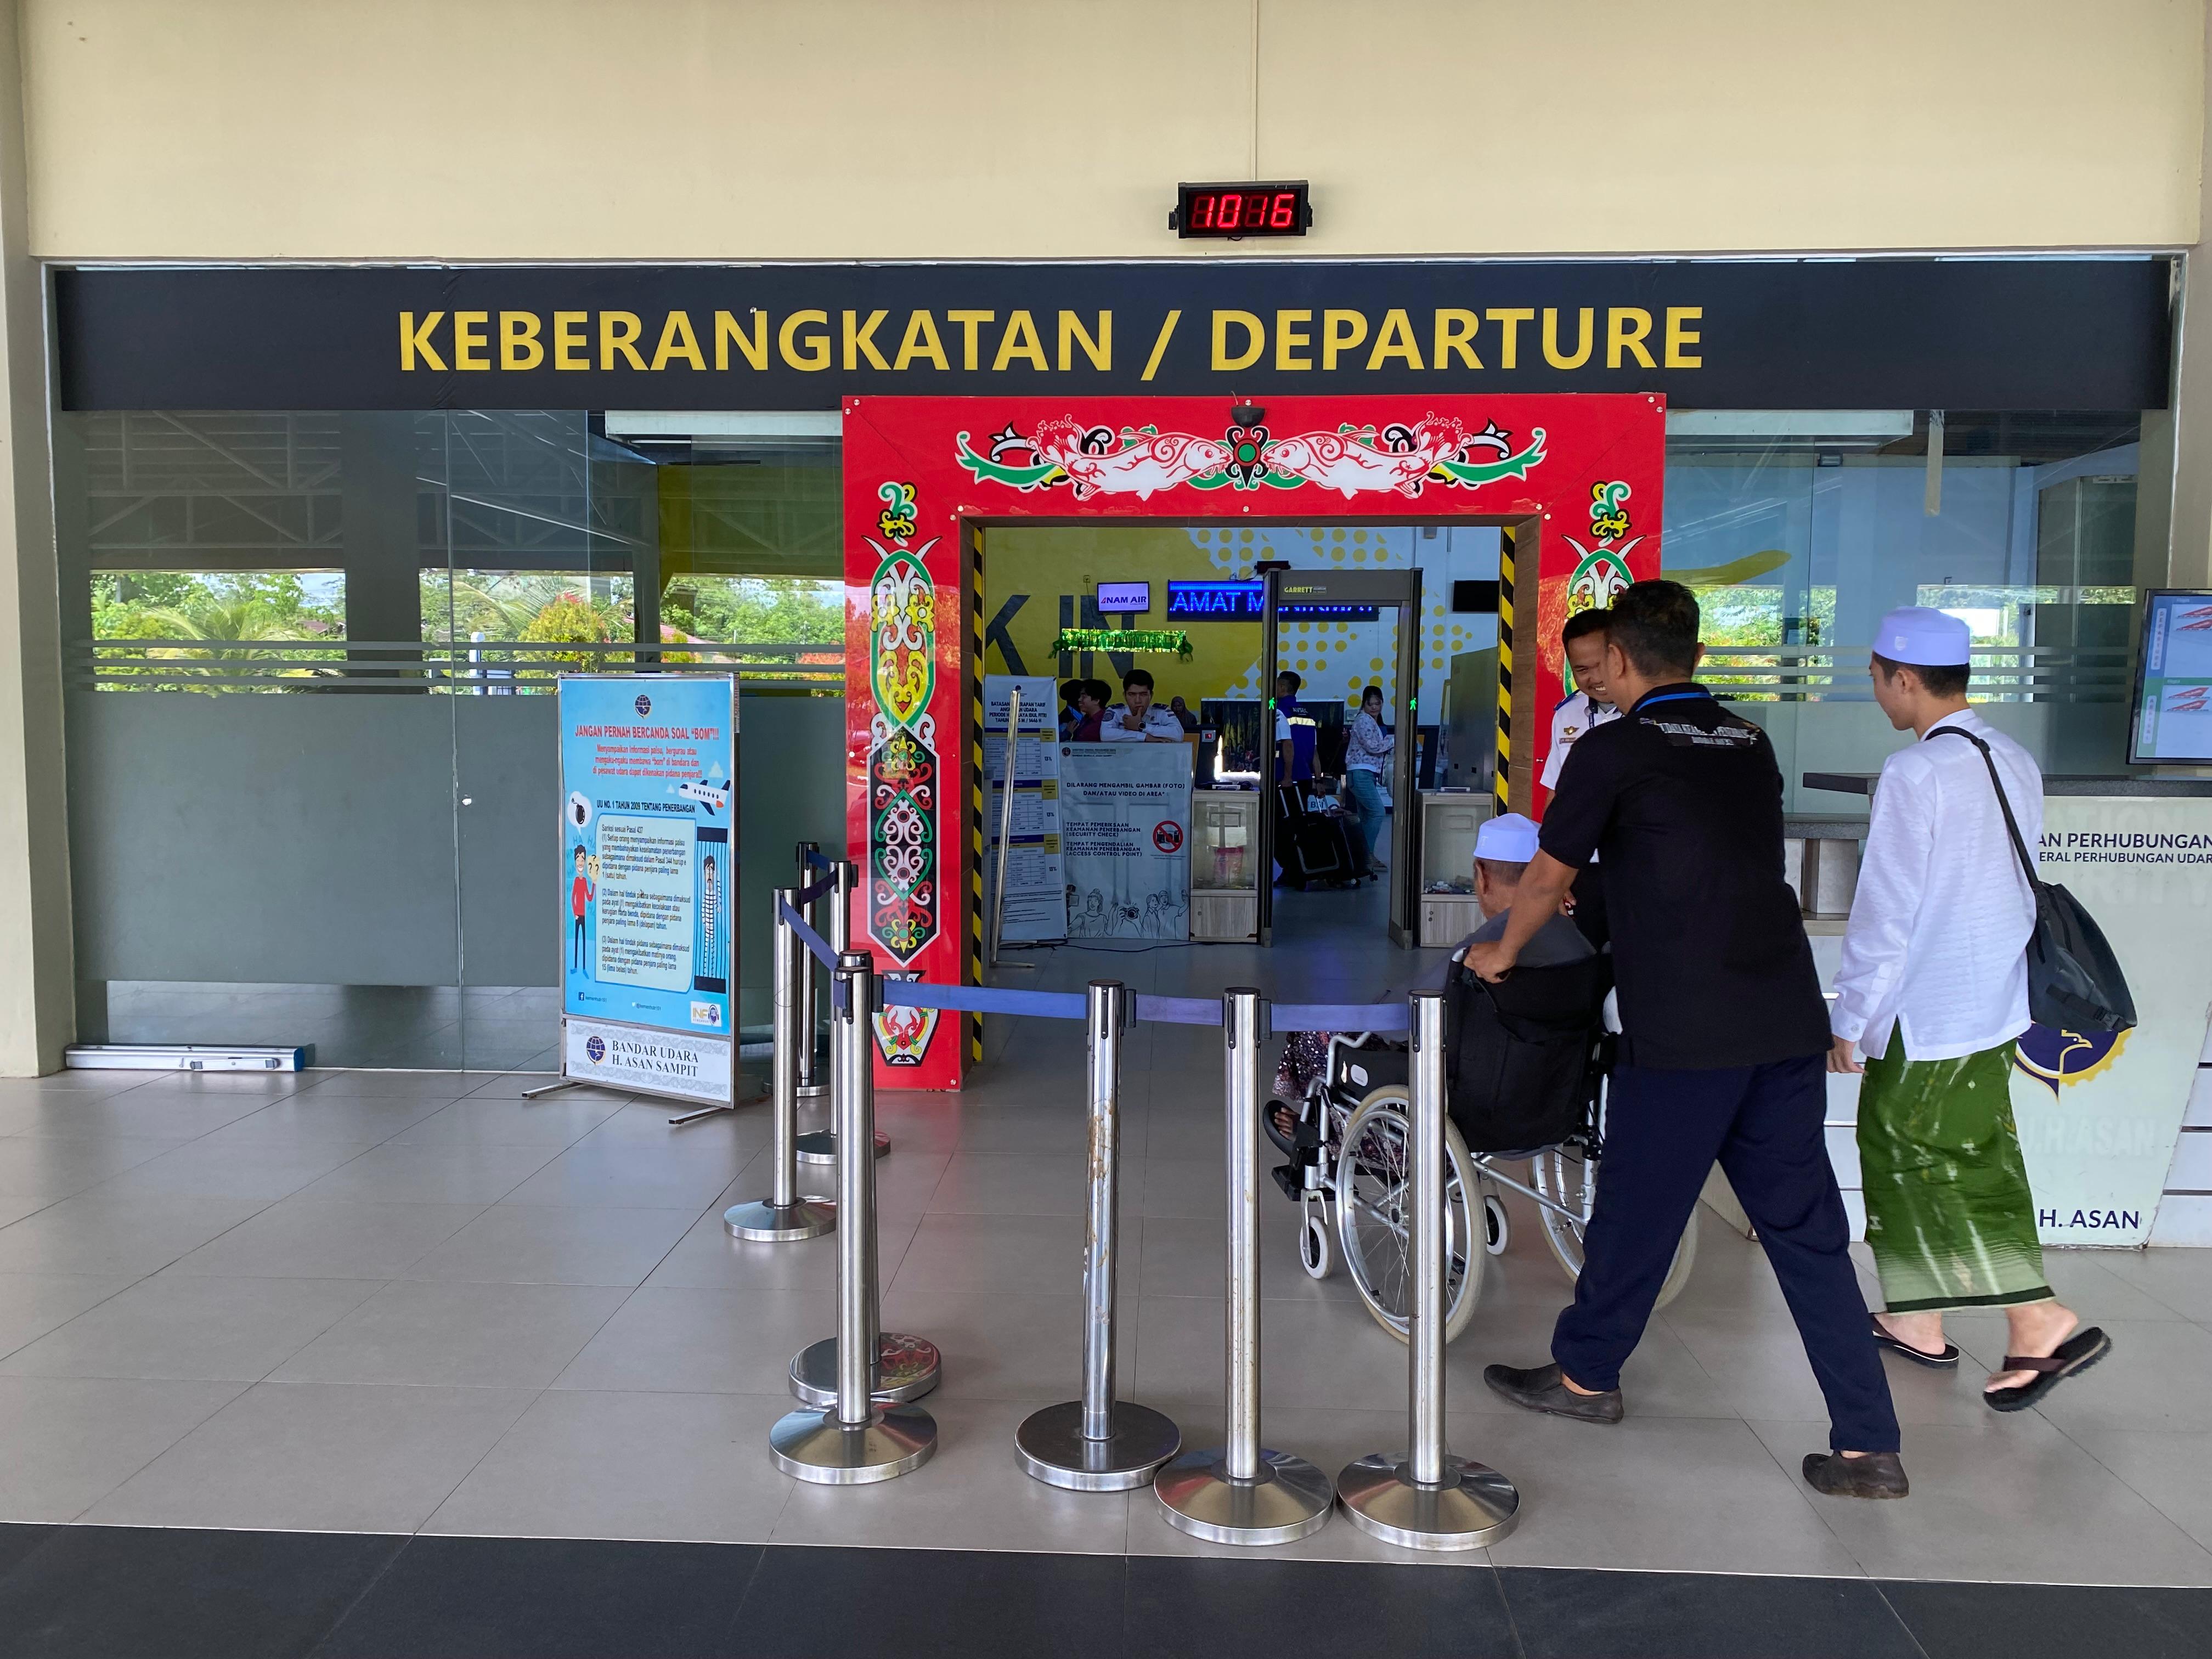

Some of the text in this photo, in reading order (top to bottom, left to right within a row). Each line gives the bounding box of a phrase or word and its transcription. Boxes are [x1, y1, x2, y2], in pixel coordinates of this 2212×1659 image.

[400, 307, 1701, 380] KEBERANGKATAN / DEPARTURE
[1059, 595, 1135, 679] IN
[575, 725, 602, 737] JANGAN
[605, 726, 630, 737] PERNAH
[633, 727, 669, 739] BERCANDA
[672, 727, 689, 740] SOAL
[616, 801, 630, 809] TAHUN
[641, 803, 661, 811] TENTANG
[663, 803, 695, 813] PENERBANGAN
[2068, 833, 2212, 849] PERHUBUNGAN
[2074, 852, 2174, 863] PERHUBUNGAN
[612, 1040, 698, 1063] BANDAR UDARA
[612, 1054, 698, 1076] H. ASAN SAMPIT
[2039, 1209, 2139, 1229] H. ASAN
